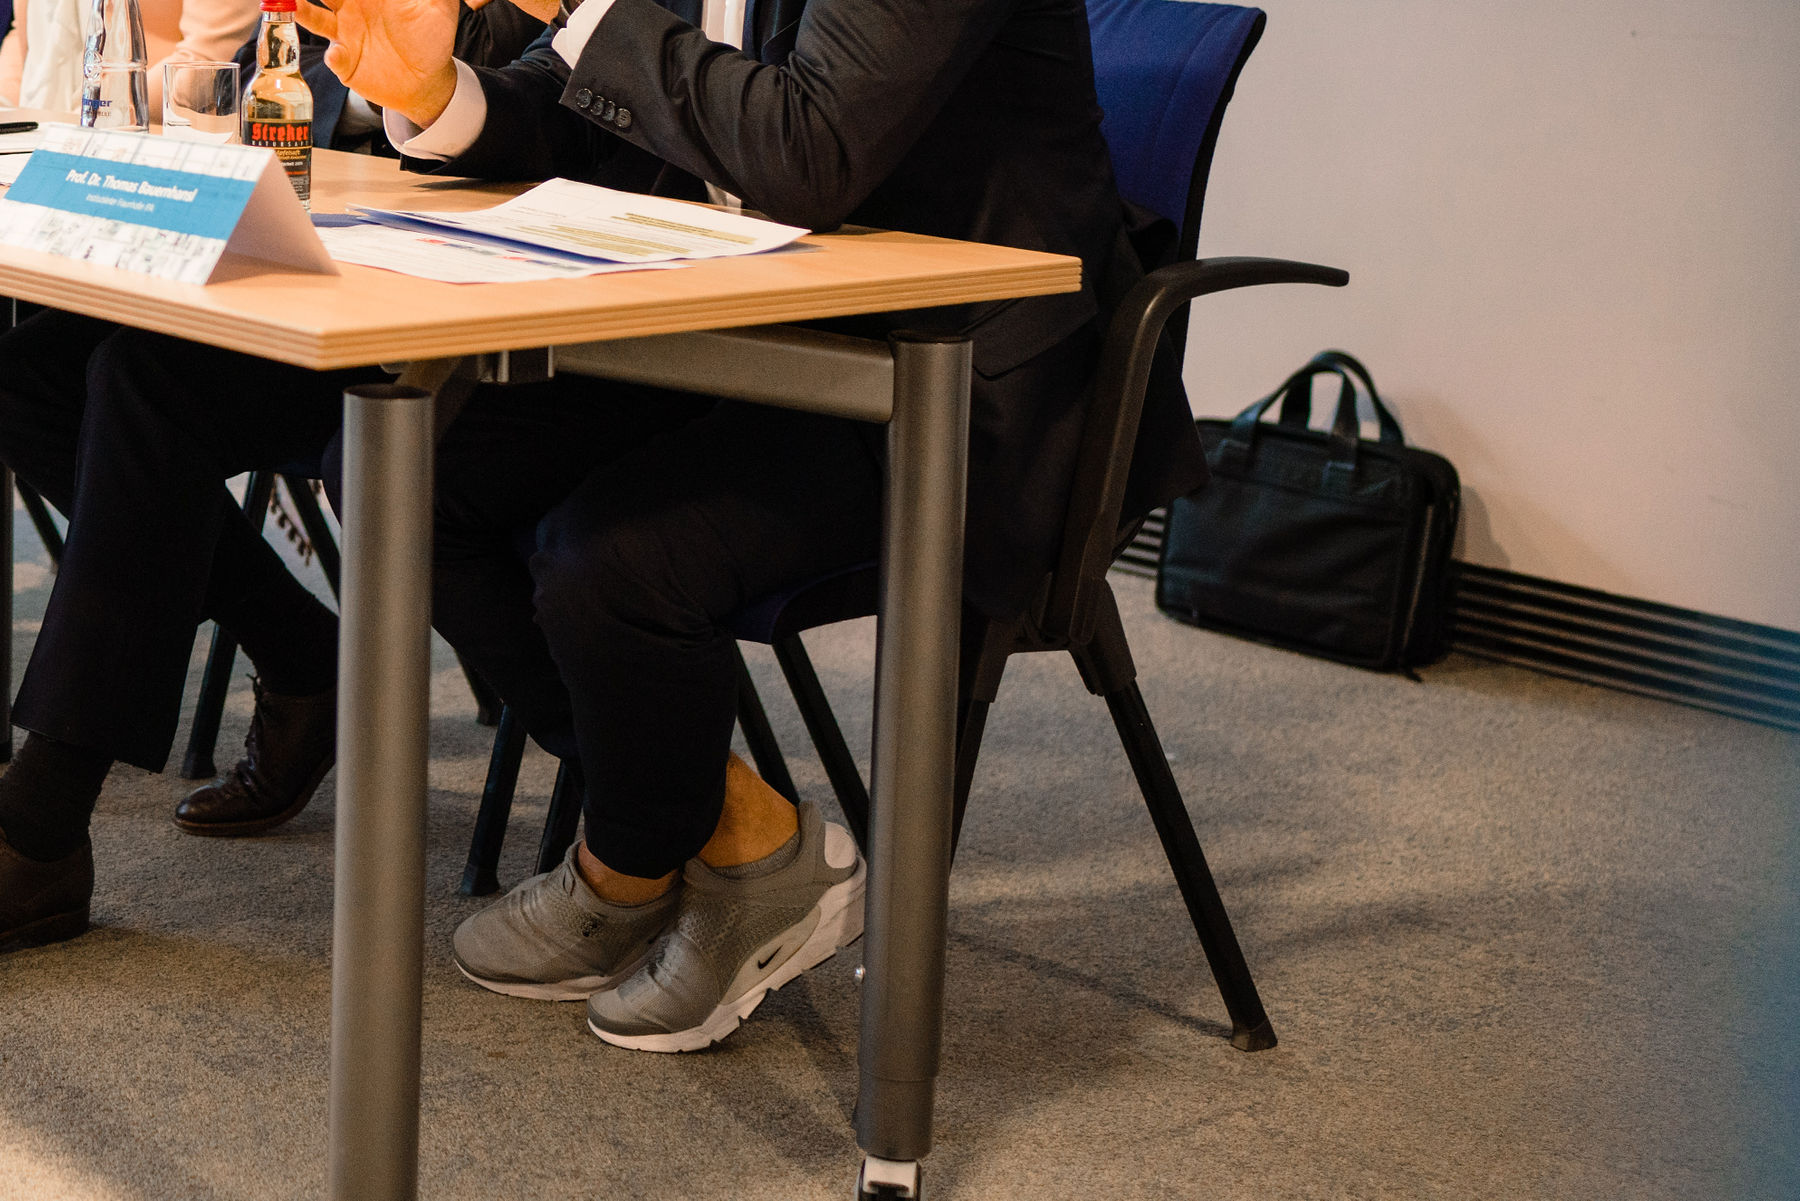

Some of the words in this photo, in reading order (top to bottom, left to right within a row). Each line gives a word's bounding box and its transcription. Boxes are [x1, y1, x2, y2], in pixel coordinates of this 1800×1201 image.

[252, 123, 309, 142] Streker
[65, 169, 89, 184] Prof.
[87, 172, 102, 187] Dr.
[102, 175, 139, 193] Thomas
[138, 181, 198, 202] Bauernhansl
